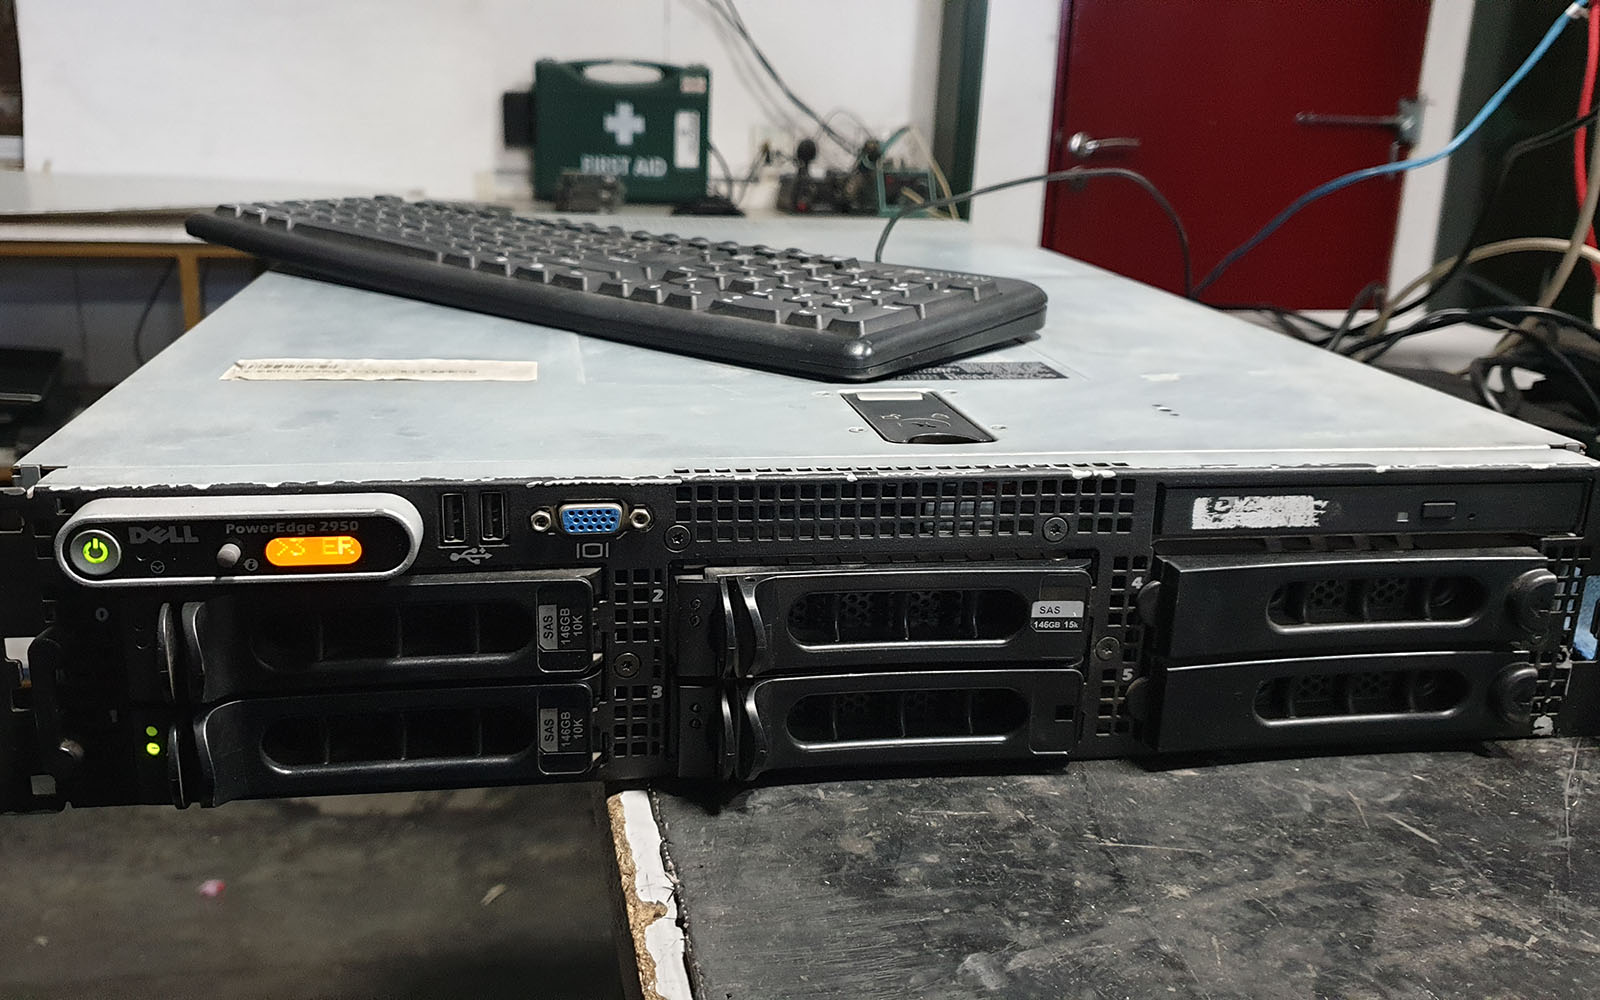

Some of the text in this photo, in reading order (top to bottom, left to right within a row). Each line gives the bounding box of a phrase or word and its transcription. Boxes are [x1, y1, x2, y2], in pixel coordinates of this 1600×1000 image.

[581, 153, 668, 178] FIRST AID
[128, 525, 200, 545] DELL
[225, 520, 359, 536] PowerEdge 2950
[1131, 576, 1144, 590] 4
[652, 589, 664, 603] 2
[1039, 605, 1061, 615] SAS
[543, 615, 554, 640] SAS
[560, 607, 571, 646] 146GB
[572, 615, 583, 637] 10K
[1033, 620, 1061, 629] 146GB
[1122, 668, 1134, 681] 5
[651, 685, 663, 699] 3
[544, 719, 554, 743] SAS
[560, 711, 571, 748] 146GB
[572, 718, 584, 740] 10K
